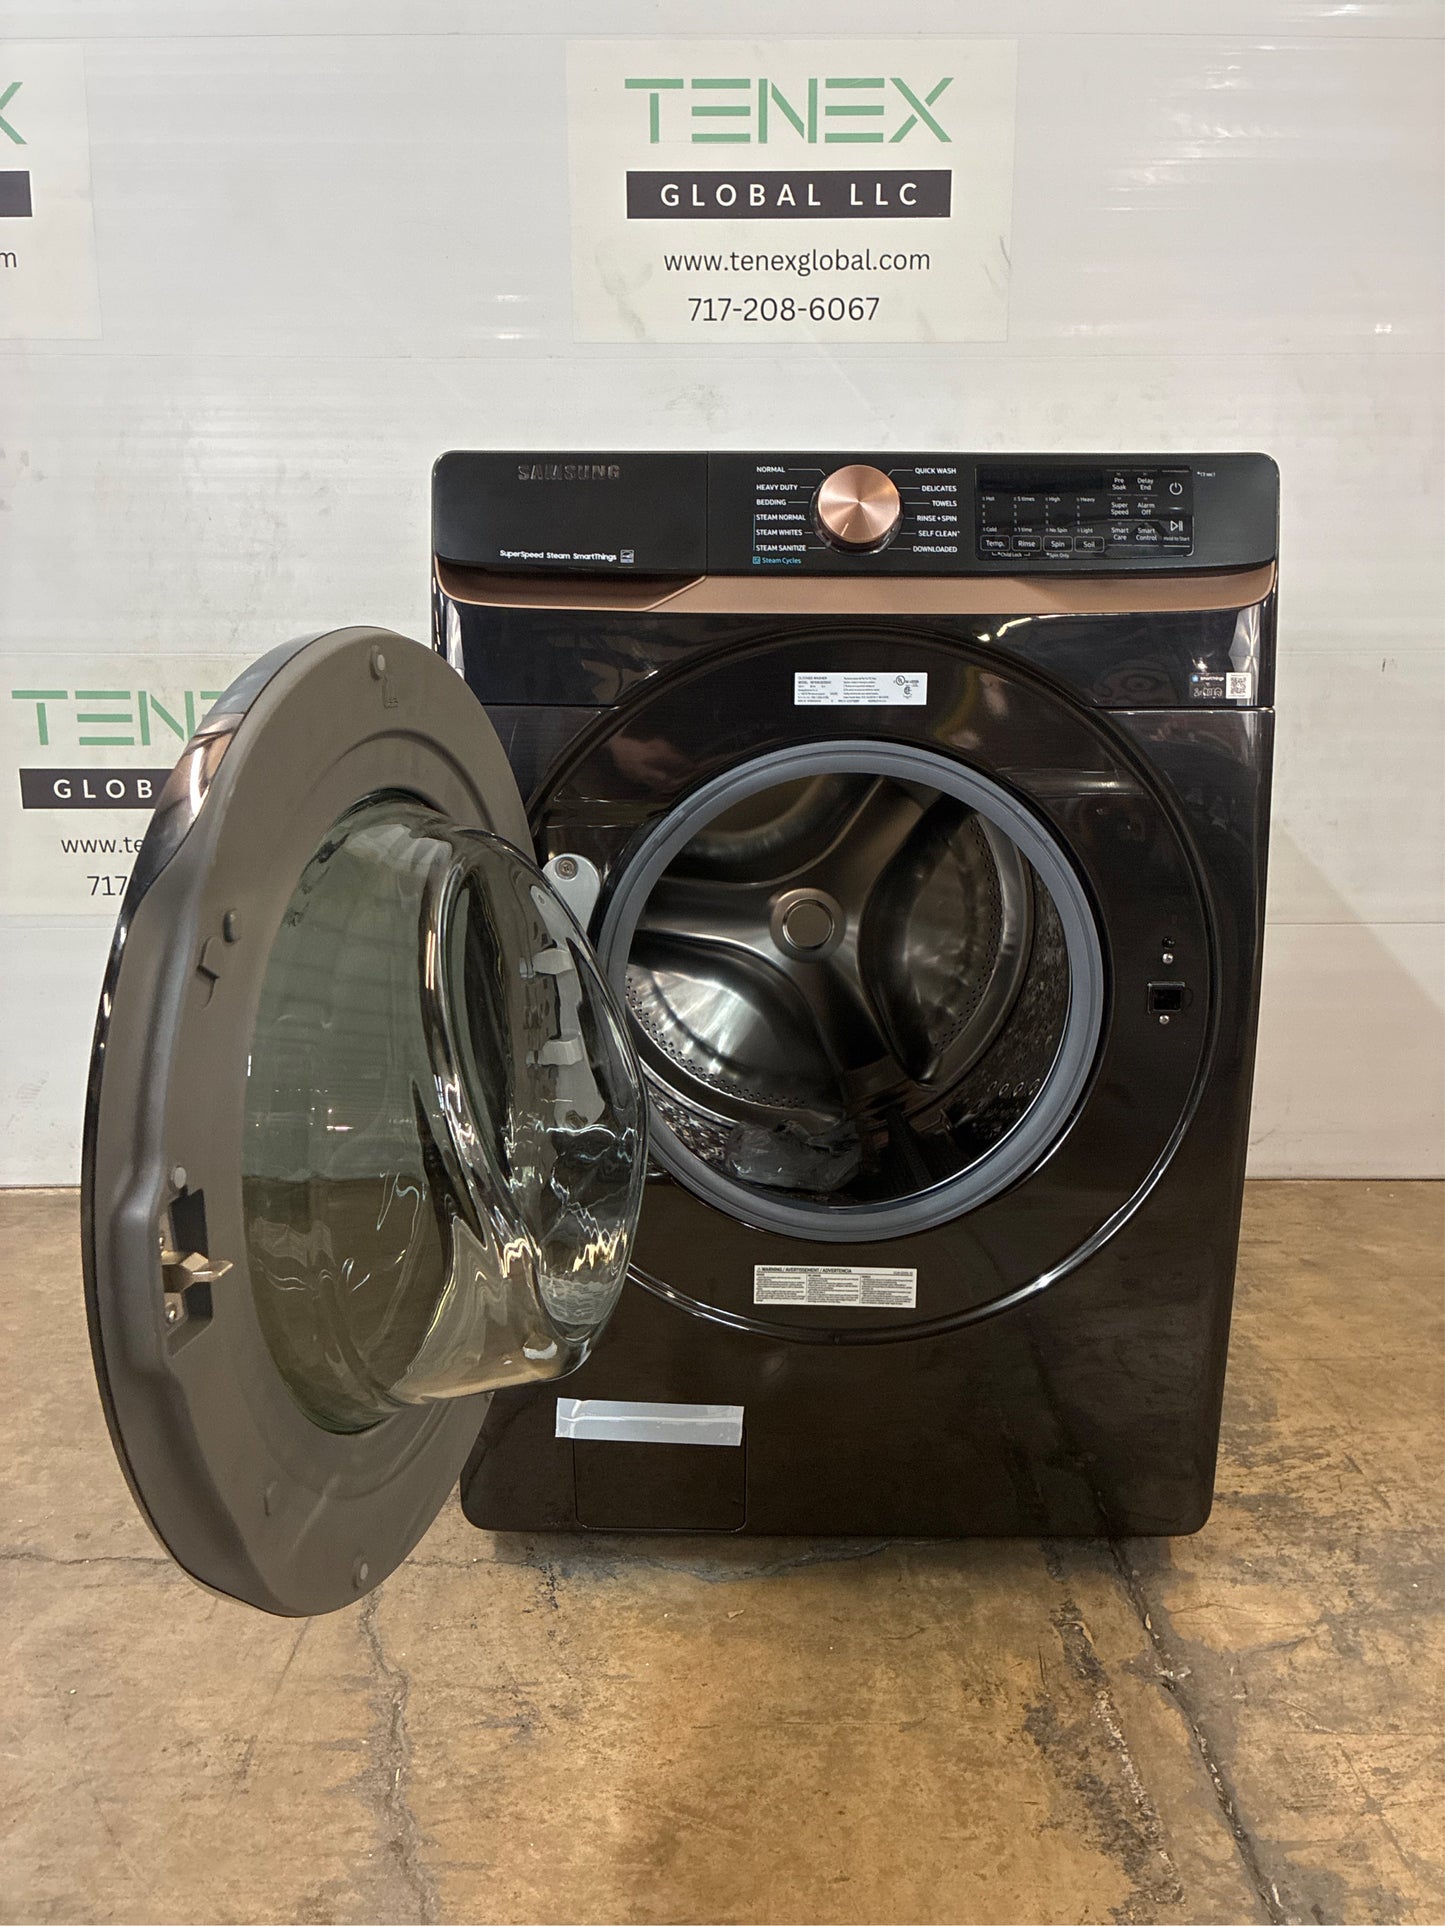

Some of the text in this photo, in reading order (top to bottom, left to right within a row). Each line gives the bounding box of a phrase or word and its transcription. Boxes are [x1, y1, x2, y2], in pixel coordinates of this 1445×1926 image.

[624, 77, 954, 144] TENEX
[660, 182, 918, 207] GLOBAL LLC
[663, 248, 931, 276] www.tenexglobal.com
[687, 297, 880, 322] 717-208-6067
[518, 464, 620, 480] SAMSUNG
[500, 550, 544, 559] SuperSpeed
[573, 552, 617, 562] SmartThings
[11, 690, 225, 746] TEN
[53, 779, 152, 798] GLOB
